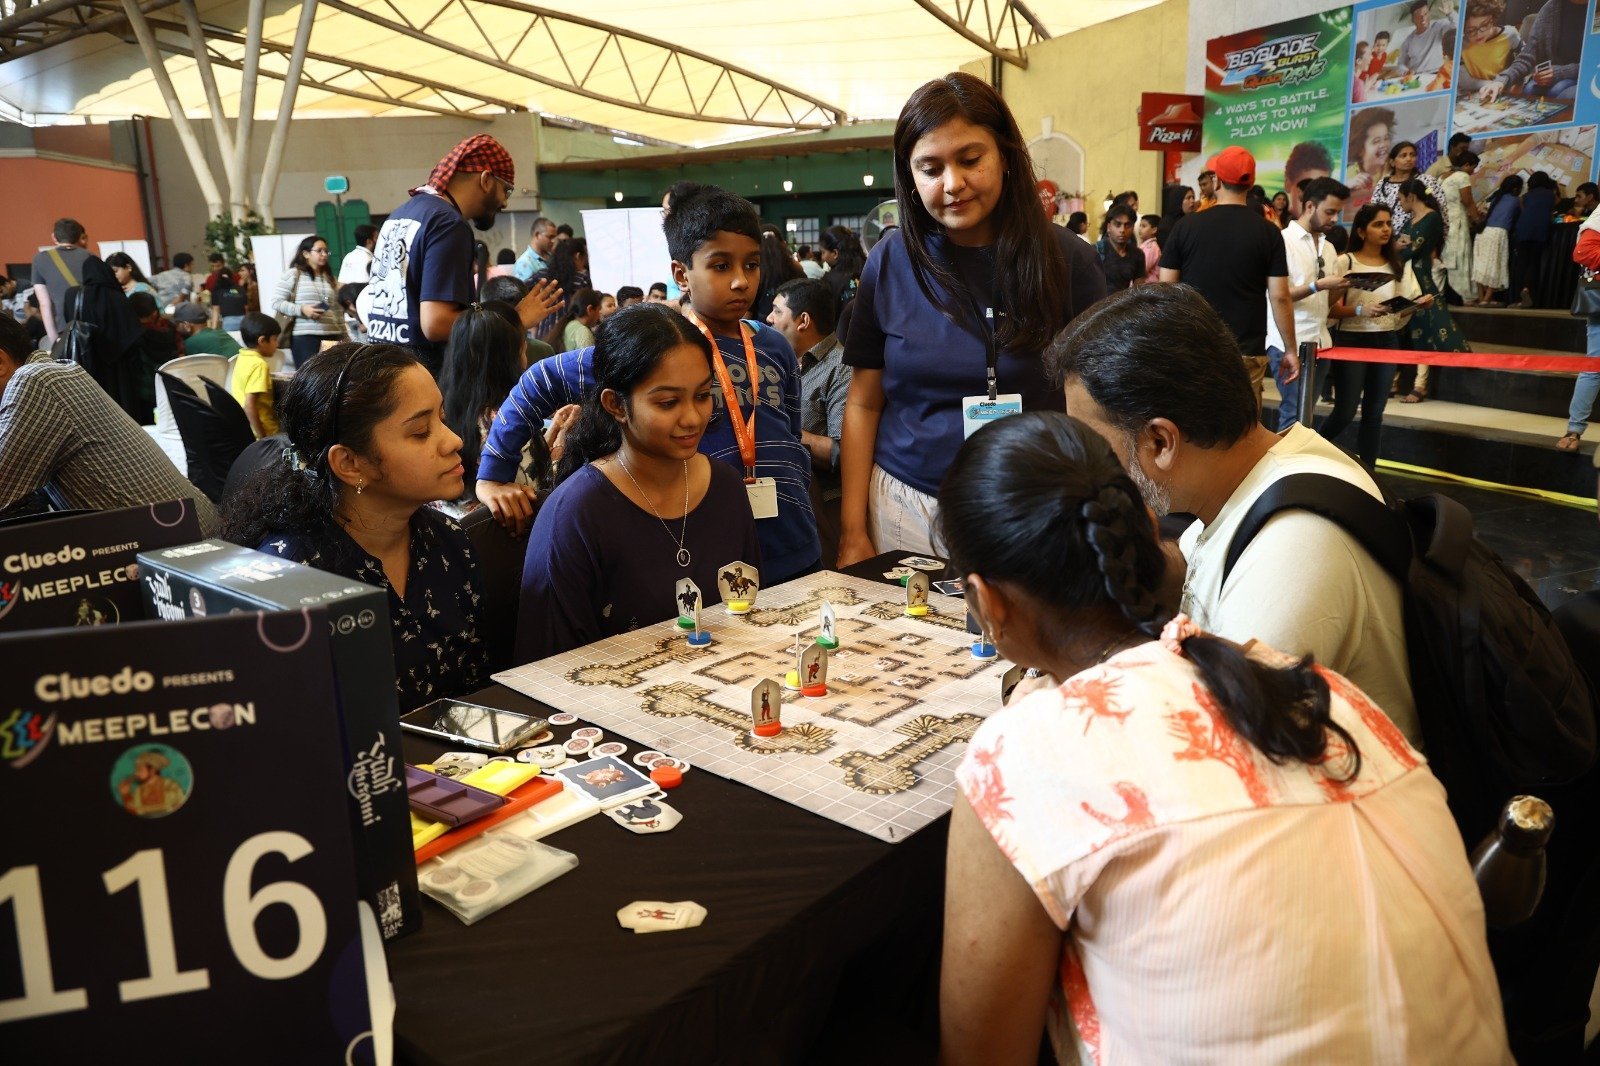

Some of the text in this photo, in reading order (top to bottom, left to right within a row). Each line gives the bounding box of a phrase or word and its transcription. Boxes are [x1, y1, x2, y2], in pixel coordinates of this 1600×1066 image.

[1228, 37, 1317, 70] BEYBLADE
[1276, 51, 1317, 67] BURST
[1226, 101, 1257, 113] WAYS
[1261, 98, 1276, 107] TO
[1236, 111, 1267, 123] WAYS
[1272, 109, 1287, 118] TO
[1290, 104, 1316, 114] WIN!
[1149, 127, 1181, 144] Pizza
[1230, 118, 1308, 138] PLAY NOW!
[367, 319, 410, 343] OZAIC
[4, 545, 86, 573] Cluedo
[92, 541, 139, 556] PRESENTS
[22, 563, 141, 602] MEEPLECO
[35, 666, 234, 702] Cluedo PRESENTS
[57, 702, 256, 746] MEEPLECON
[0, 831, 327, 1023] 116
